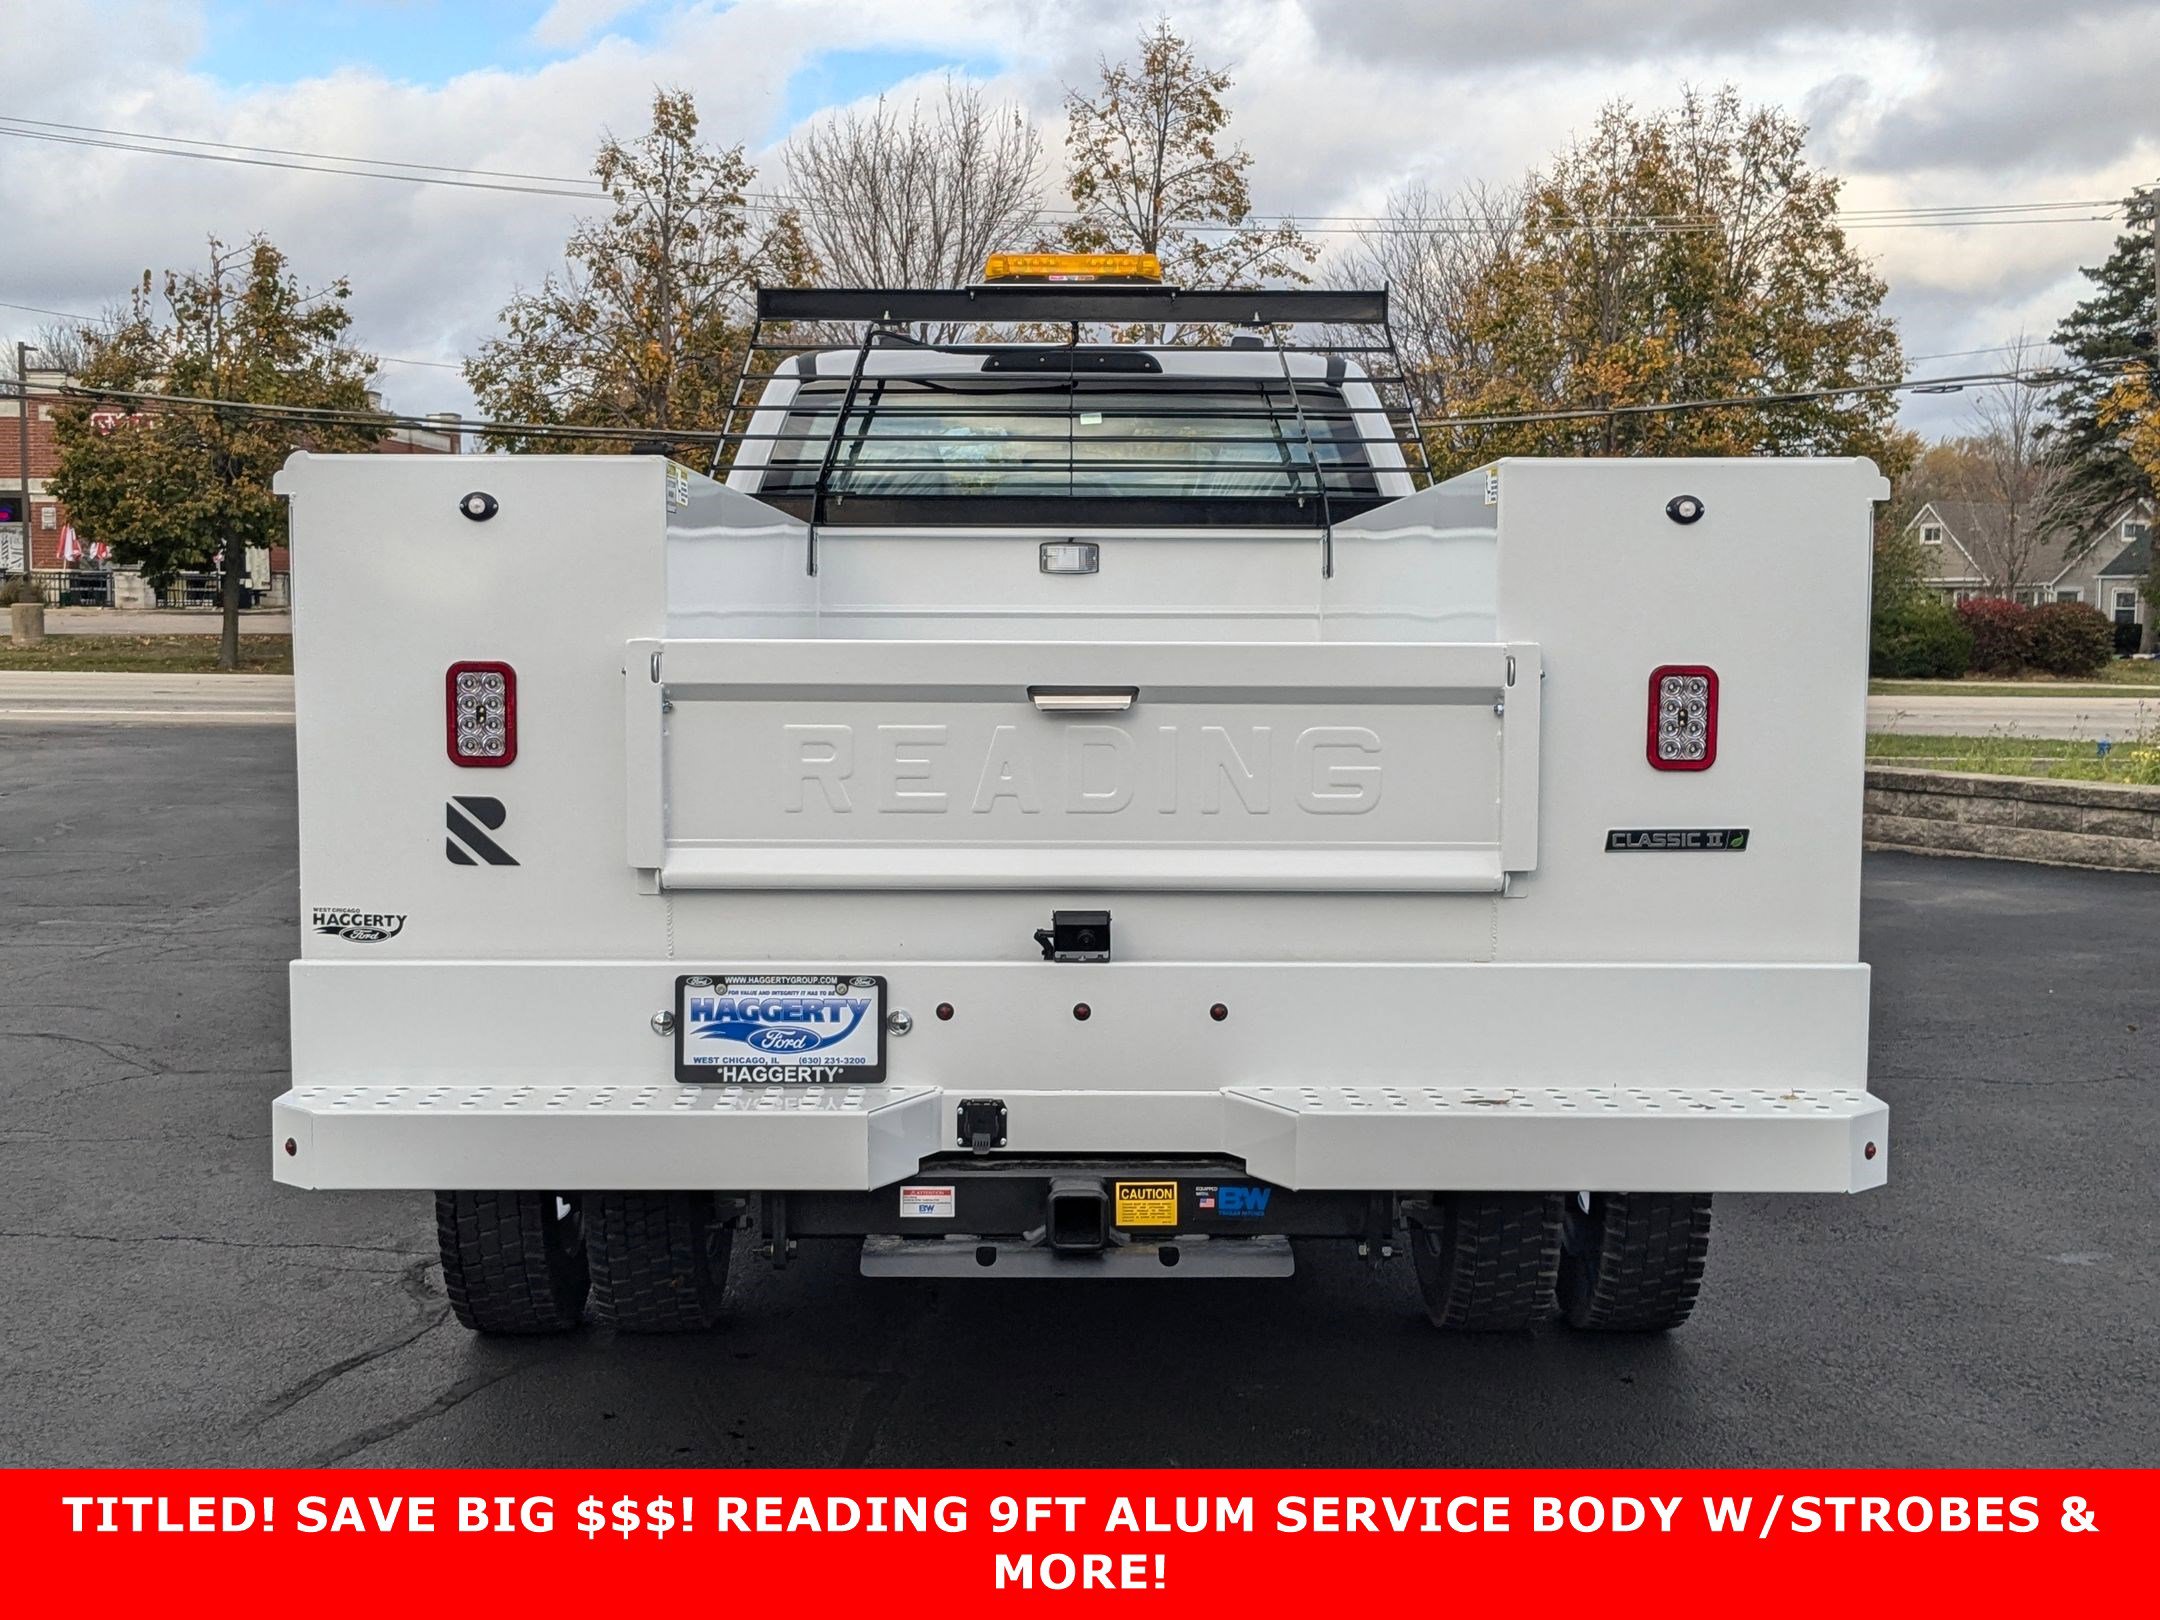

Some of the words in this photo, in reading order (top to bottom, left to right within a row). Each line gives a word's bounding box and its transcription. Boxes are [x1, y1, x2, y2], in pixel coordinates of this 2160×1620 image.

[784, 724, 1383, 815] READING
[1612, 833, 1701, 848] CLASSIC
[313, 913, 408, 927] HAGGERTY
[350, 930, 379, 940] Ford
[725, 976, 838, 984] WWW.HAGGERTYGROUP.COM
[690, 997, 872, 1023] HAGGERTY
[761, 1029, 806, 1049] Ford
[693, 1056, 719, 1064] WEST
[722, 1056, 768, 1066] CHICAGO,
[771, 1056, 780, 1064] IL
[798, 1056, 822, 1065] (630)
[824, 1056, 866, 1064] 231-3200
[1121, 1188, 1173, 1200] CAUTION
